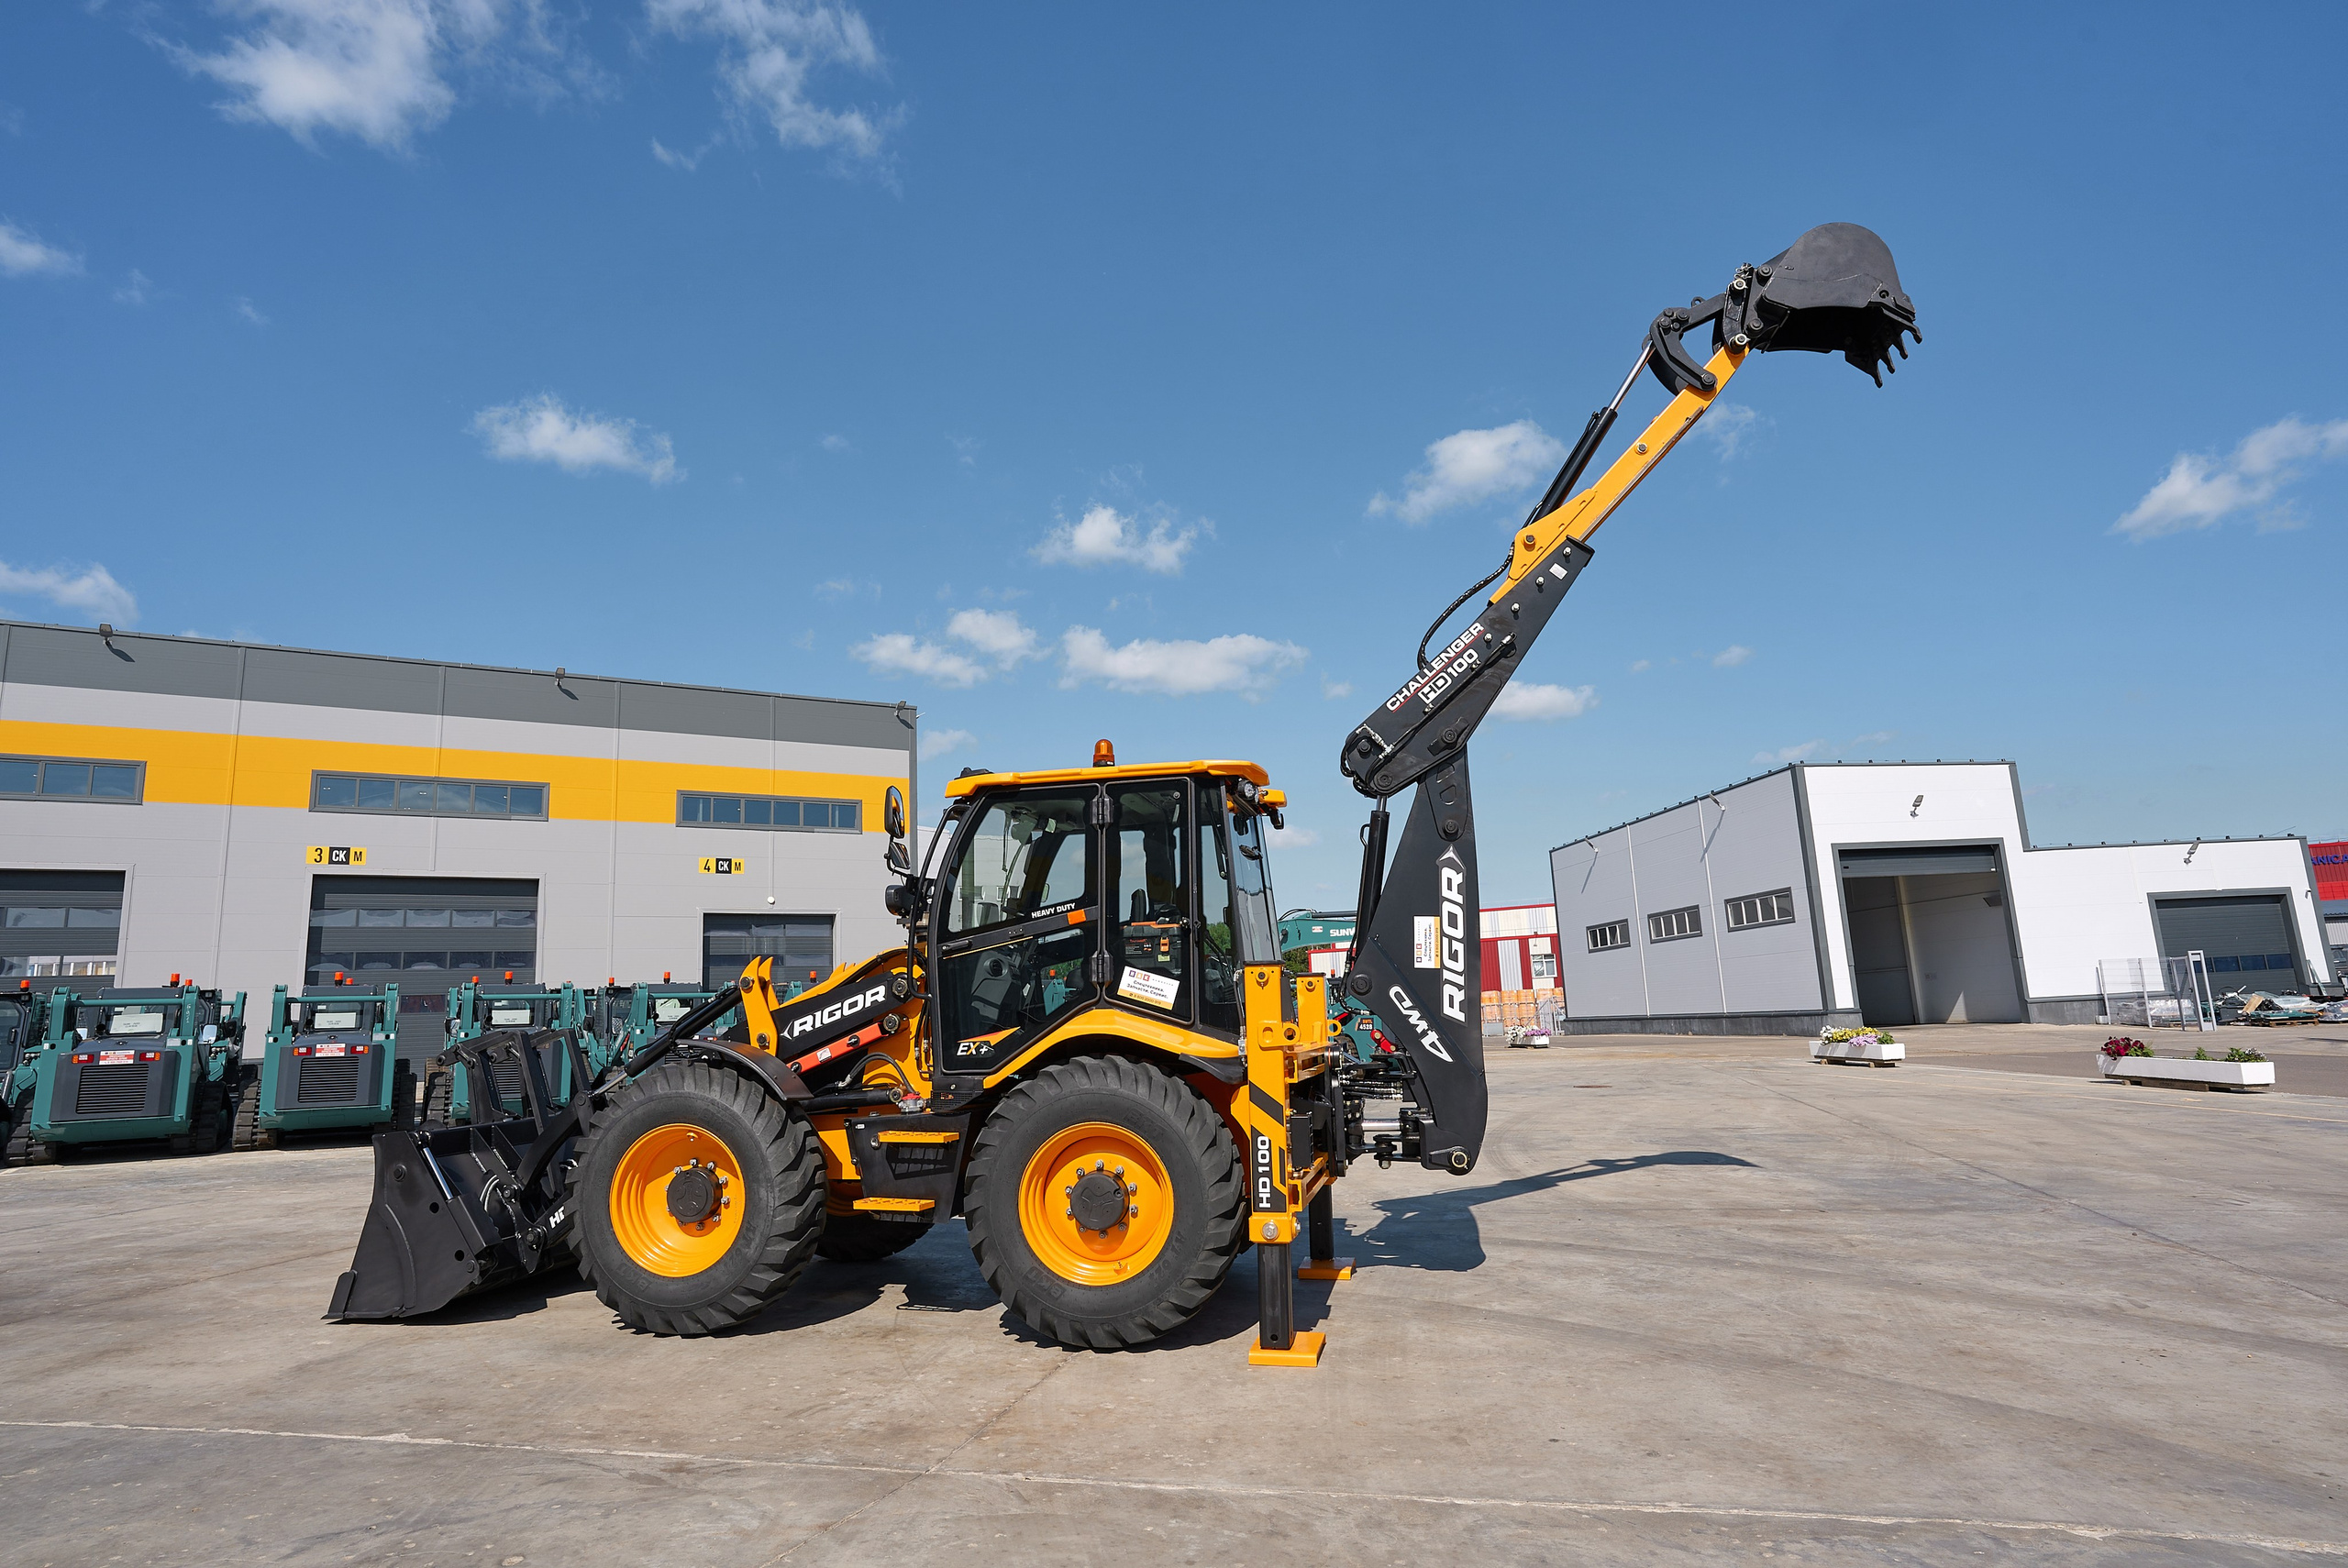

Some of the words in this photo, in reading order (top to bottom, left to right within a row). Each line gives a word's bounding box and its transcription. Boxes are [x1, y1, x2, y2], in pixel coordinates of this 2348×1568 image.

[1386, 623, 1484, 712] CHALLENGER
[314, 847, 323, 863] 3
[703, 858, 711, 872] 4
[1031, 907, 1055, 918] HEAVY
[1057, 902, 1076, 912] DUTY
[1441, 867, 1466, 1022] RIGOR
[792, 985, 886, 1038] RIGOR
